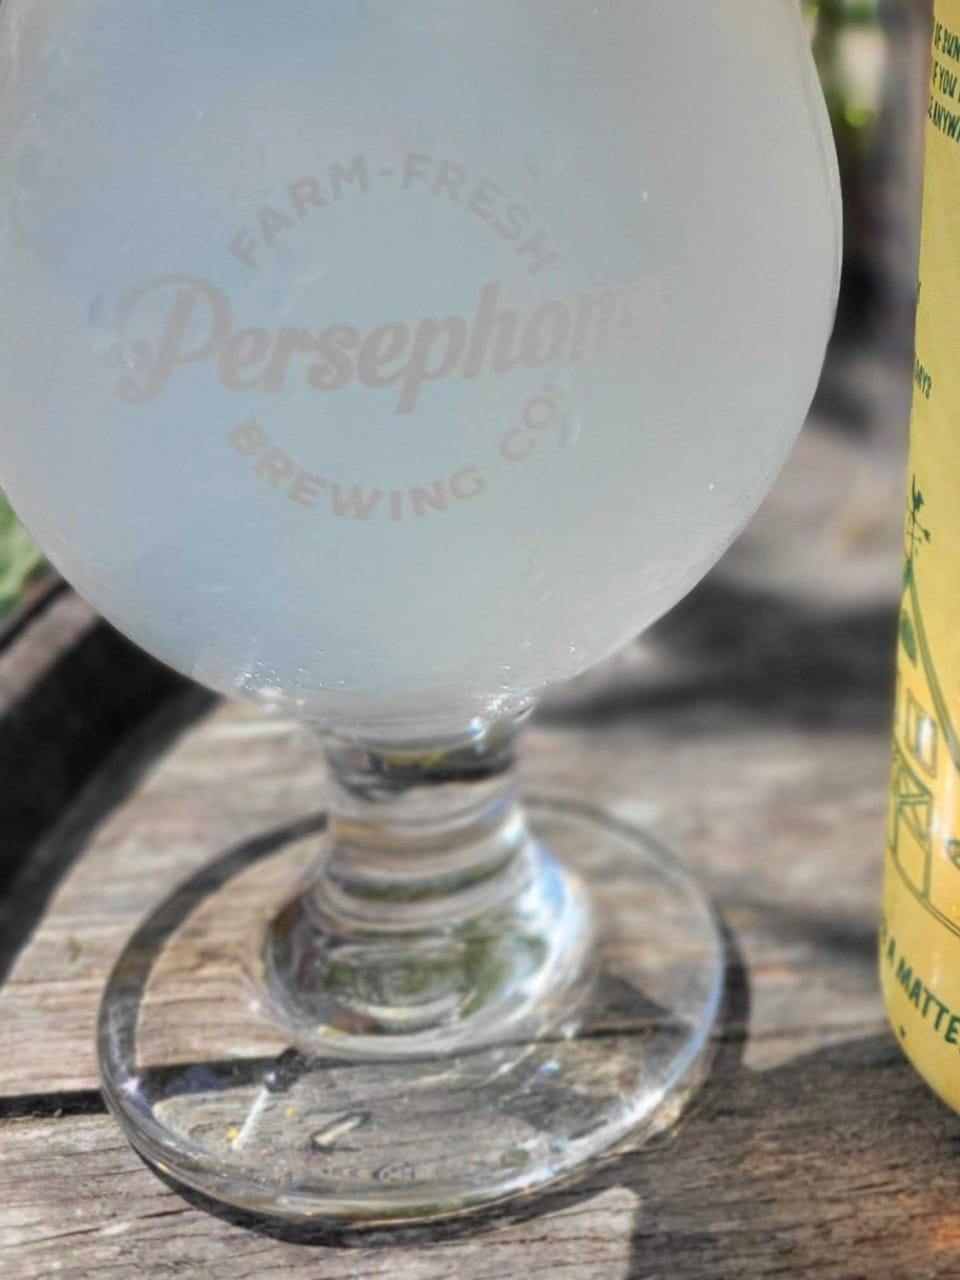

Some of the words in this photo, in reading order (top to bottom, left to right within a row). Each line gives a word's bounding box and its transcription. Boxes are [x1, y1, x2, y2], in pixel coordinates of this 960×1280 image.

[938, 64, 957, 99] YOU
[228, 152, 560, 277] FARM-FRESH
[226, 418, 489, 521] BREWING
